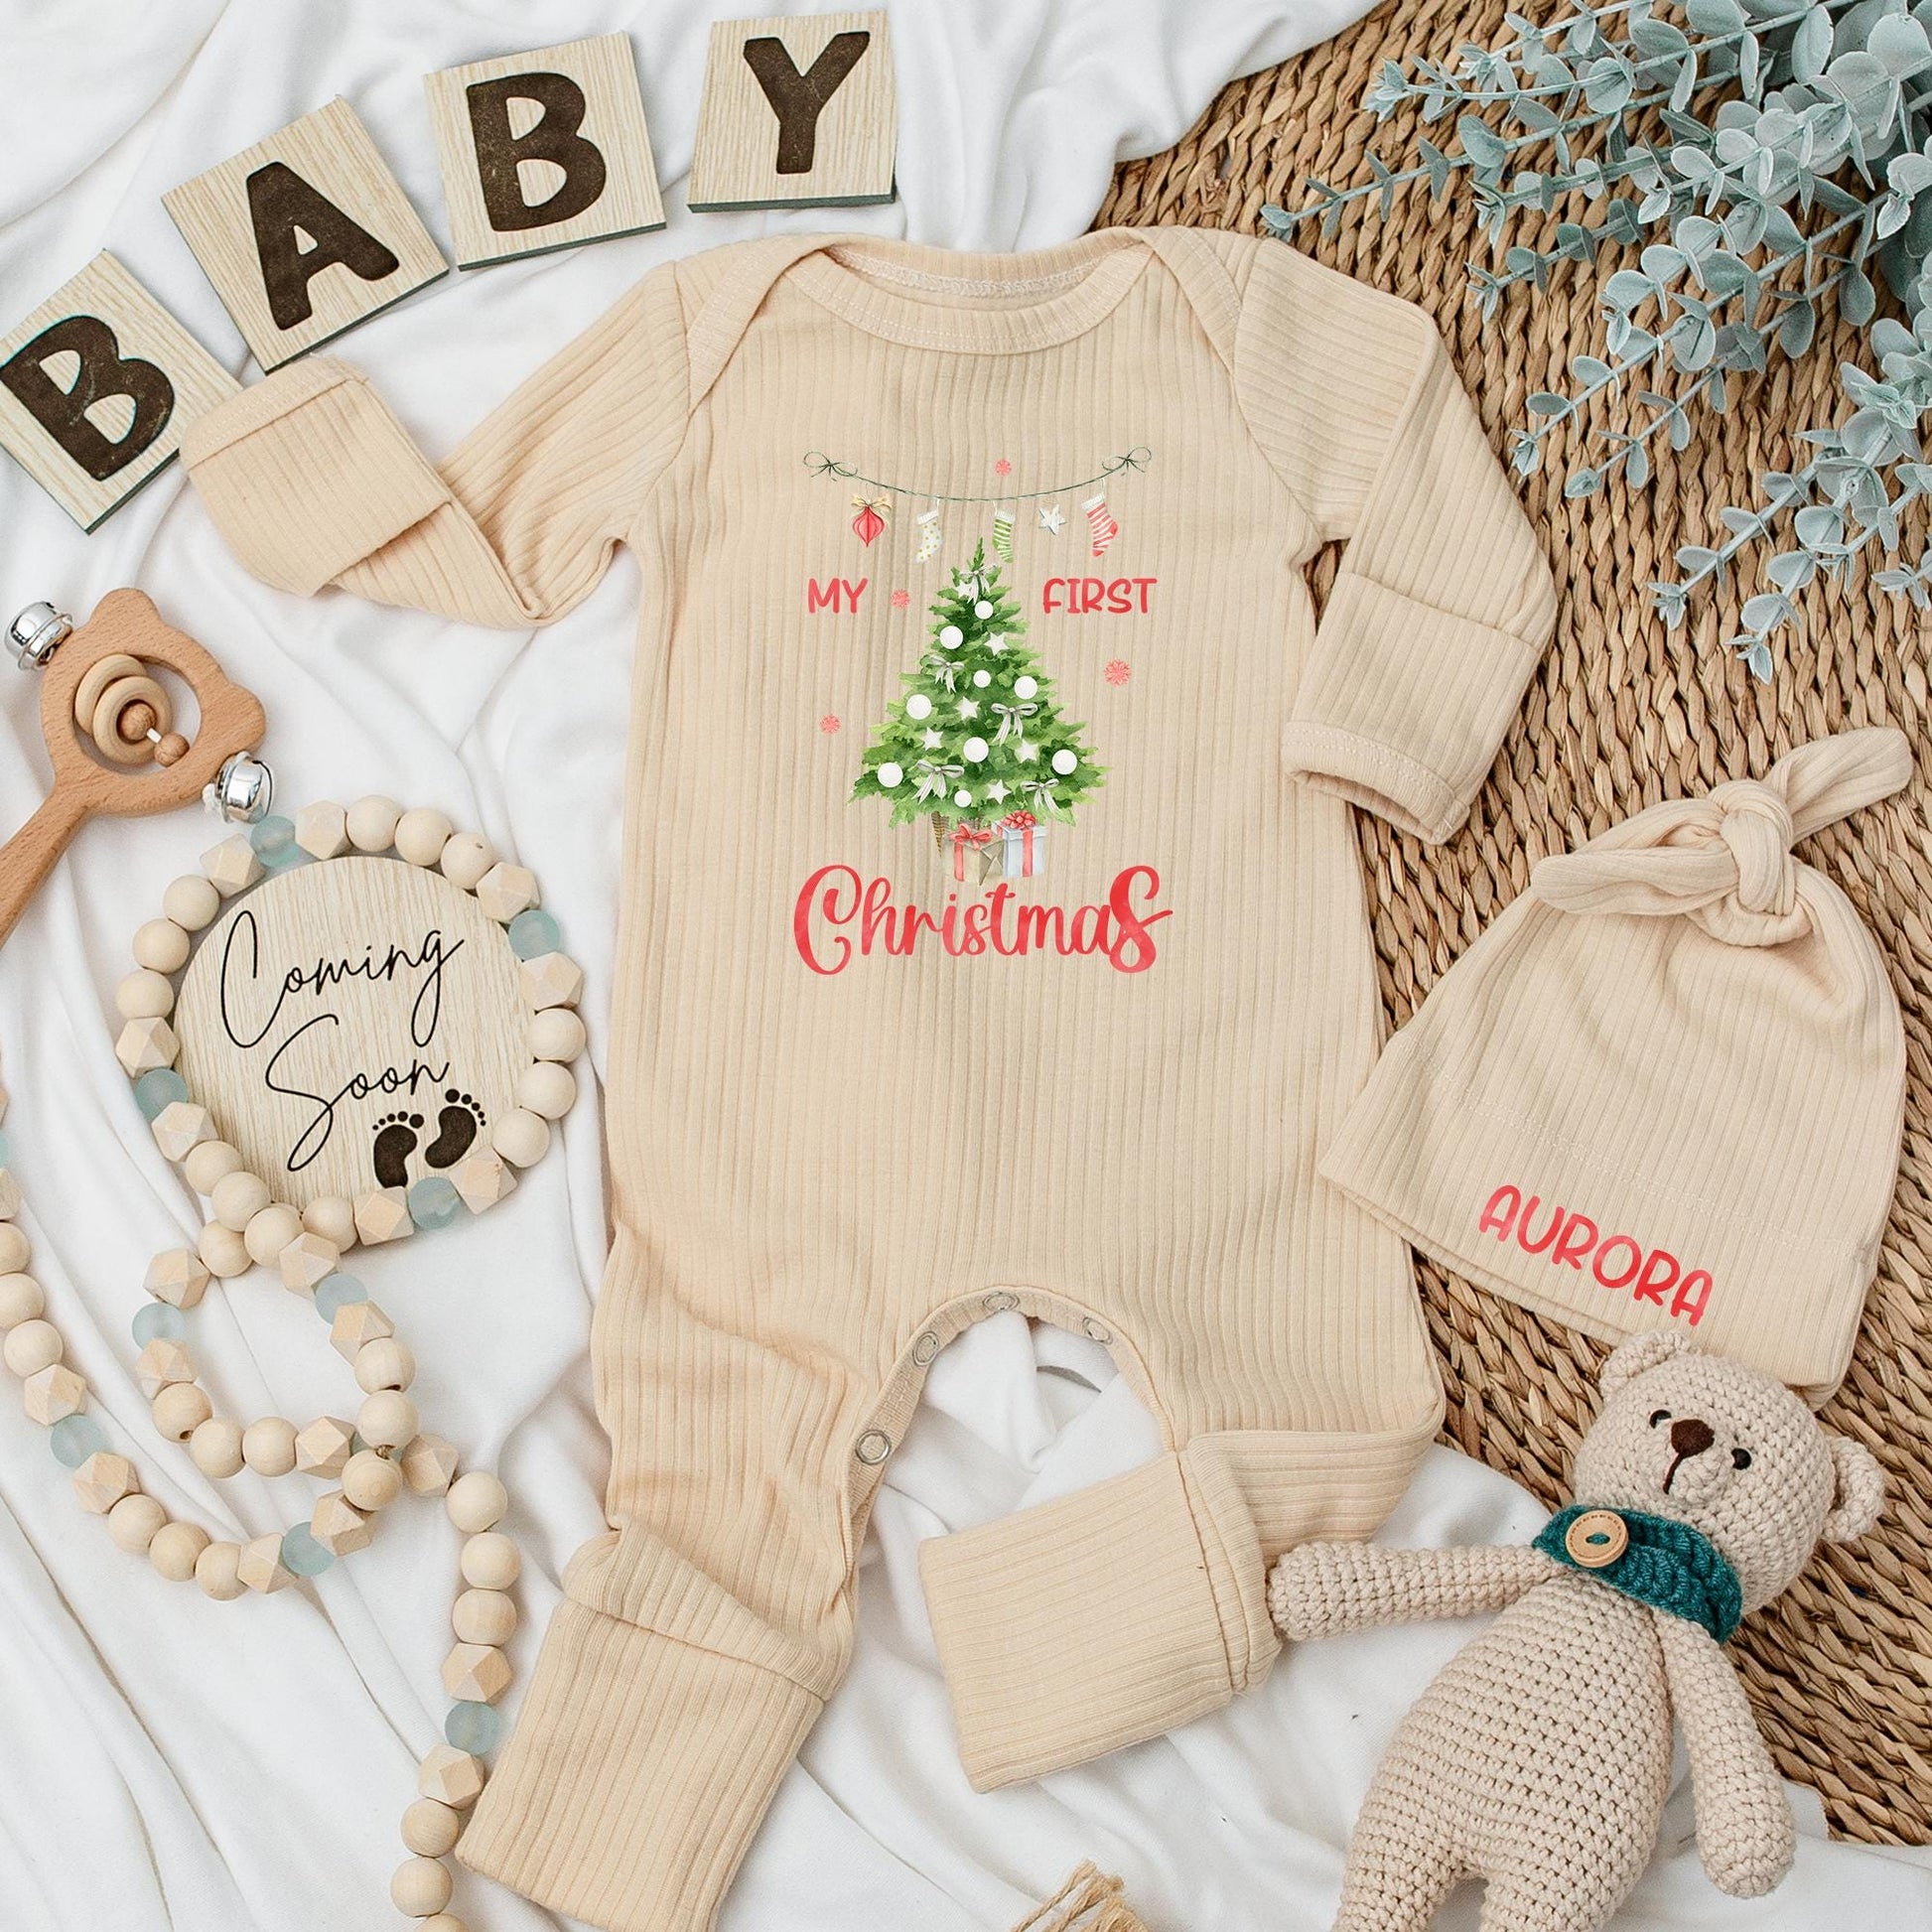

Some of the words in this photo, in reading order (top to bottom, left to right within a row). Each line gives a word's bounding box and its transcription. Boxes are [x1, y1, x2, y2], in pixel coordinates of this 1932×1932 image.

[0, 31, 871, 483] BABY
[807, 578, 869, 614] MY
[1042, 578, 1158, 615] FIRST
[220, 909, 466, 1047] Coming
[265, 1014, 451, 1172] Soon
[1478, 1184, 1714, 1326] AURORA
